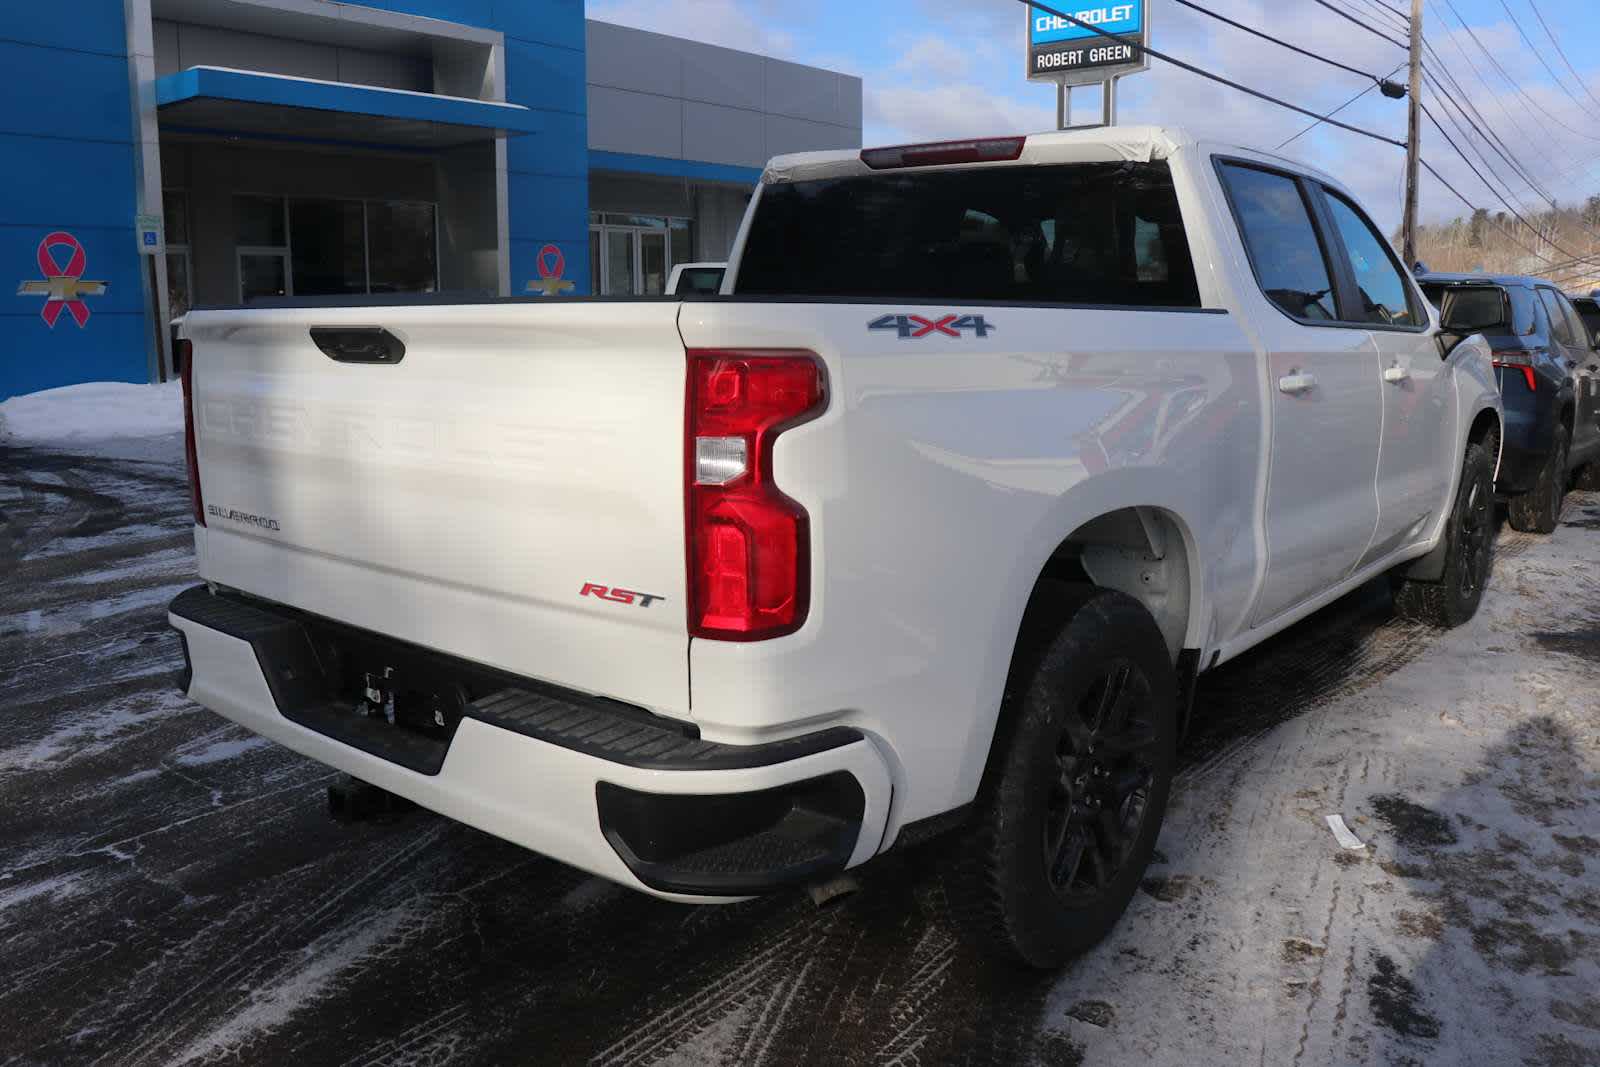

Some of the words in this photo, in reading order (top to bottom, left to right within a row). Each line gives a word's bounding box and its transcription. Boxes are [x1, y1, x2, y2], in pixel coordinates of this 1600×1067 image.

[1037, 51, 1083, 68] ROBERT
[1089, 45, 1131, 63] GREEN
[579, 582, 666, 608] RST
